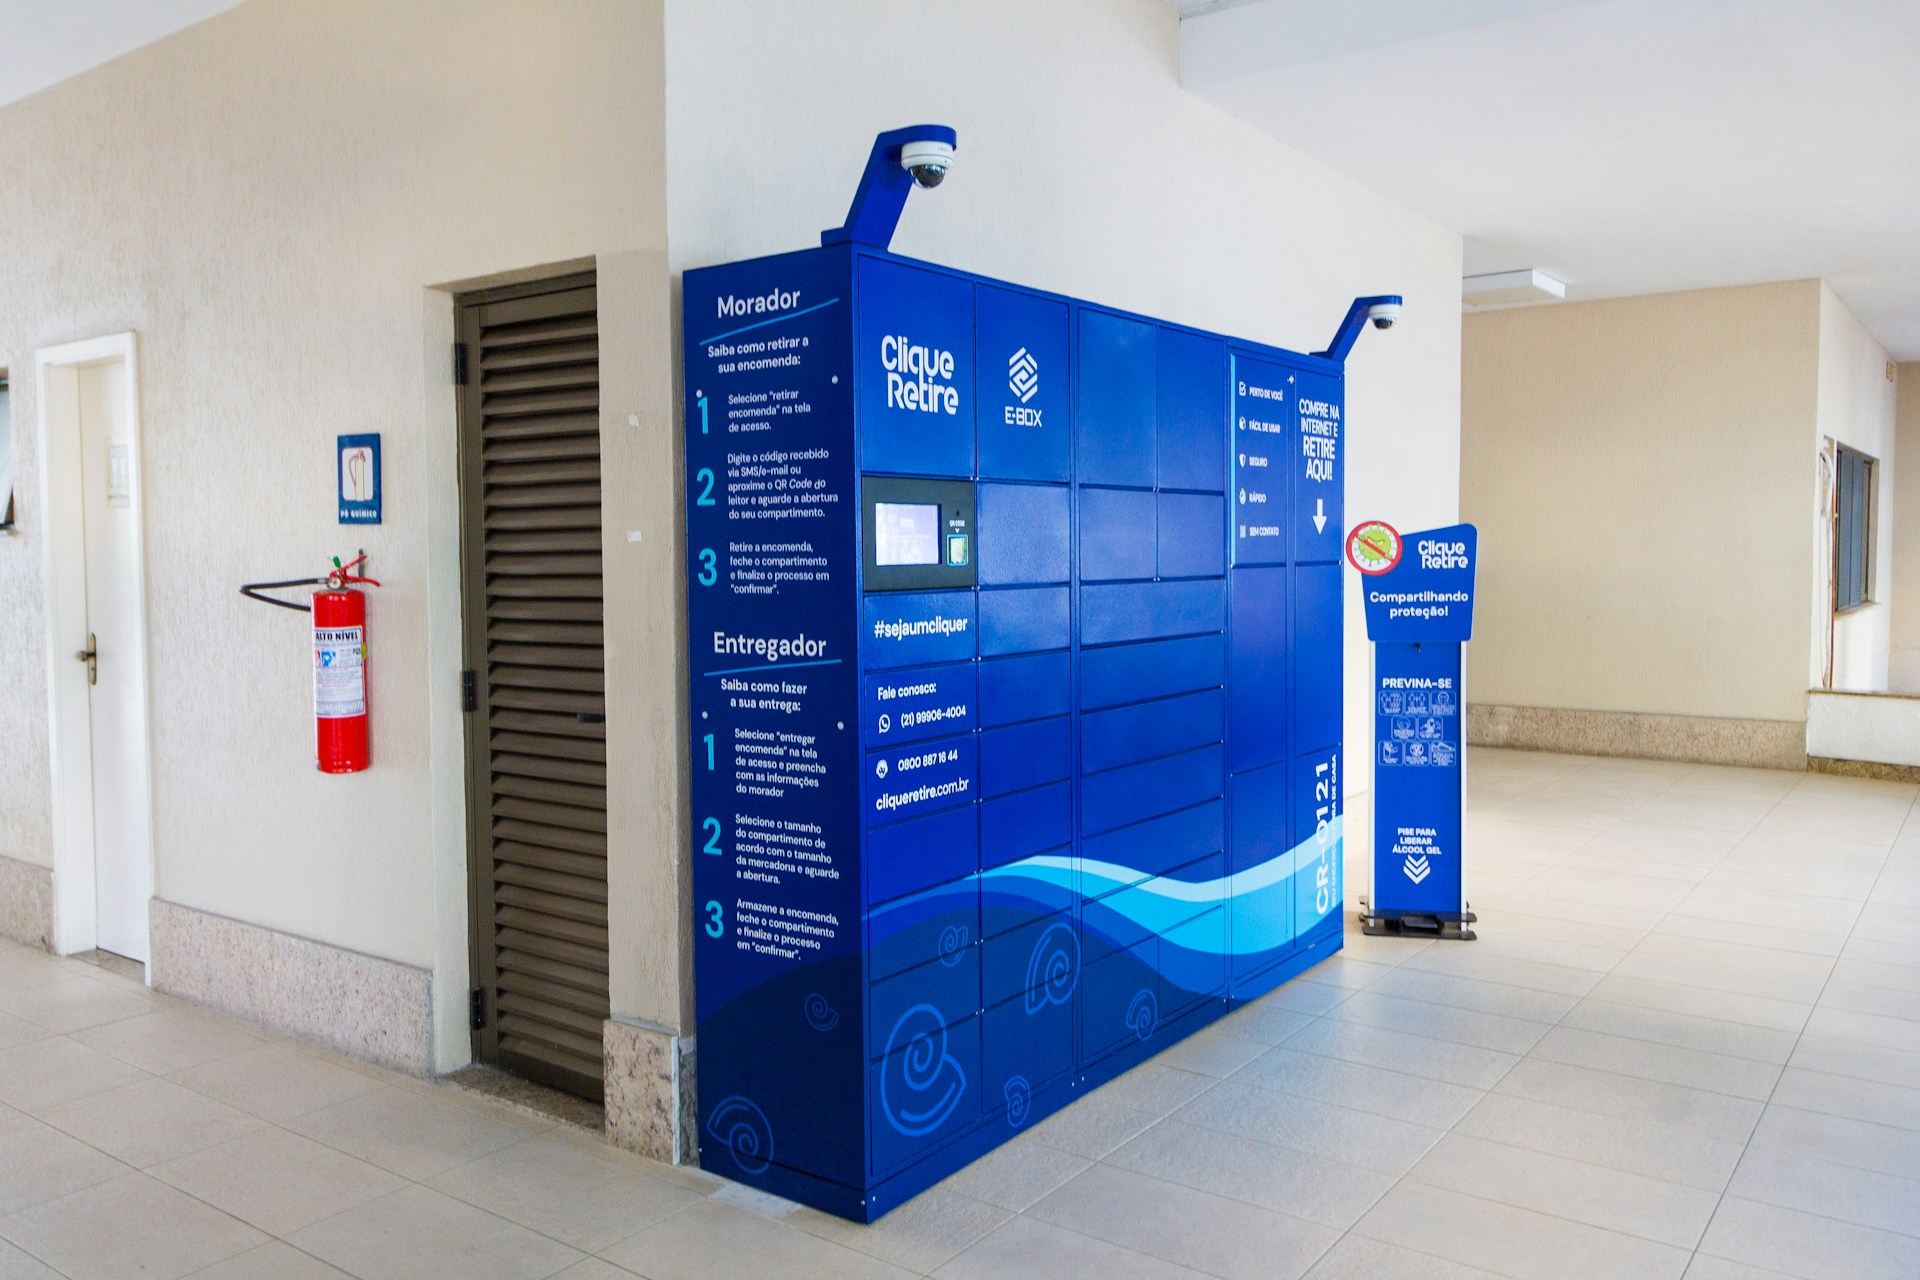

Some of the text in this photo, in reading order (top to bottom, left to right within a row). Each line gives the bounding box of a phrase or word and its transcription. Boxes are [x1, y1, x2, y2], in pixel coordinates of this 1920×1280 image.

[717, 287, 800, 318] Morador
[708, 337, 809, 358] Saiba como retirar a
[718, 353, 801, 374] sua encomenda:
[881, 334, 955, 380] Clique
[728, 393, 767, 405] Selecione
[887, 372, 959, 415] Retire
[1249, 386, 1263, 398] PERTO
[1264, 389, 1271, 399] DE
[697, 397, 709, 434] 1
[782, 405, 792, 414] na
[795, 402, 811, 413] tela
[1299, 398, 1340, 420] COMPRE NA
[728, 421, 771, 433] de acesso.
[1301, 417, 1338, 437] INTERNET E
[1303, 435, 1336, 460] RETIRE
[728, 448, 829, 466] Digite o código recebido
[1249, 456, 1268, 467] SEGURO
[728, 464, 801, 478] via SMS/e-mail ou
[1306, 458, 1333, 483] AQUI!
[696, 467, 716, 506] 2
[728, 478, 826, 494] aproxime o QR Code do
[728, 492, 838, 507] leitor e aguarde a abertura
[1249, 491, 1266, 503] RÁPIDO
[350, 509, 377, 518] QUÍMICO
[729, 507, 825, 520] do seu compartimento.
[1249, 526, 1279, 537] SEM CONTATO
[729, 541, 813, 553] Retire a encomenda,
[1418, 540, 1465, 556] Clique
[698, 548, 717, 586] 3
[730, 556, 827, 568] feche o compartimento
[1421, 554, 1469, 569] Retire
[730, 570, 829, 582] e finalize o processo em
[1369, 591, 1469, 605] Compartilhando
[1389, 606, 1448, 619] proteção!
[315, 630, 358, 641] ALTO NÍVEL
[874, 615, 968, 641] #sejaumcliquer
[714, 631, 826, 661] Entregador
[721, 678, 807, 694] Saiba como fazer
[1382, 678, 1452, 689] PREVINA-SE
[878, 683, 937, 701] Fale conosco:
[730, 698, 801, 714] a sua entrega:
[900, 705, 967, 728] (21) 99906-4004
[734, 728, 774, 741] Selecione
[703, 733, 714, 771] 1
[789, 748, 800, 757] na
[801, 747, 818, 759] tela
[735, 756, 826, 774] de acesso e preencha
[898, 749, 958, 772] 0800 887 16 44
[735, 771, 819, 788] com as informações
[736, 783, 784, 797] do morador
[876, 777, 969, 811] cliqueretire.com.br
[735, 813, 821, 834] Selecione o tamanho
[1397, 827, 1436, 836] PISE PARA
[703, 817, 722, 856] 2
[736, 828, 826, 849] do compartimento de
[1400, 837, 1432, 845] LIBERAR
[736, 842, 832, 864] acordo com o tamanho
[1392, 844, 1442, 855] ÁLCOOL GEL
[736, 855, 839, 879] da mercadoria e aguarde
[736, 870, 780, 884] a abertura.
[705, 900, 724, 938] 3
[737, 898, 839, 926] Armazene a encomenda,
[737, 912, 834, 938] feche o compartimento
[737, 926, 821, 950] e finalize o processo
[737, 941, 750, 950] em
